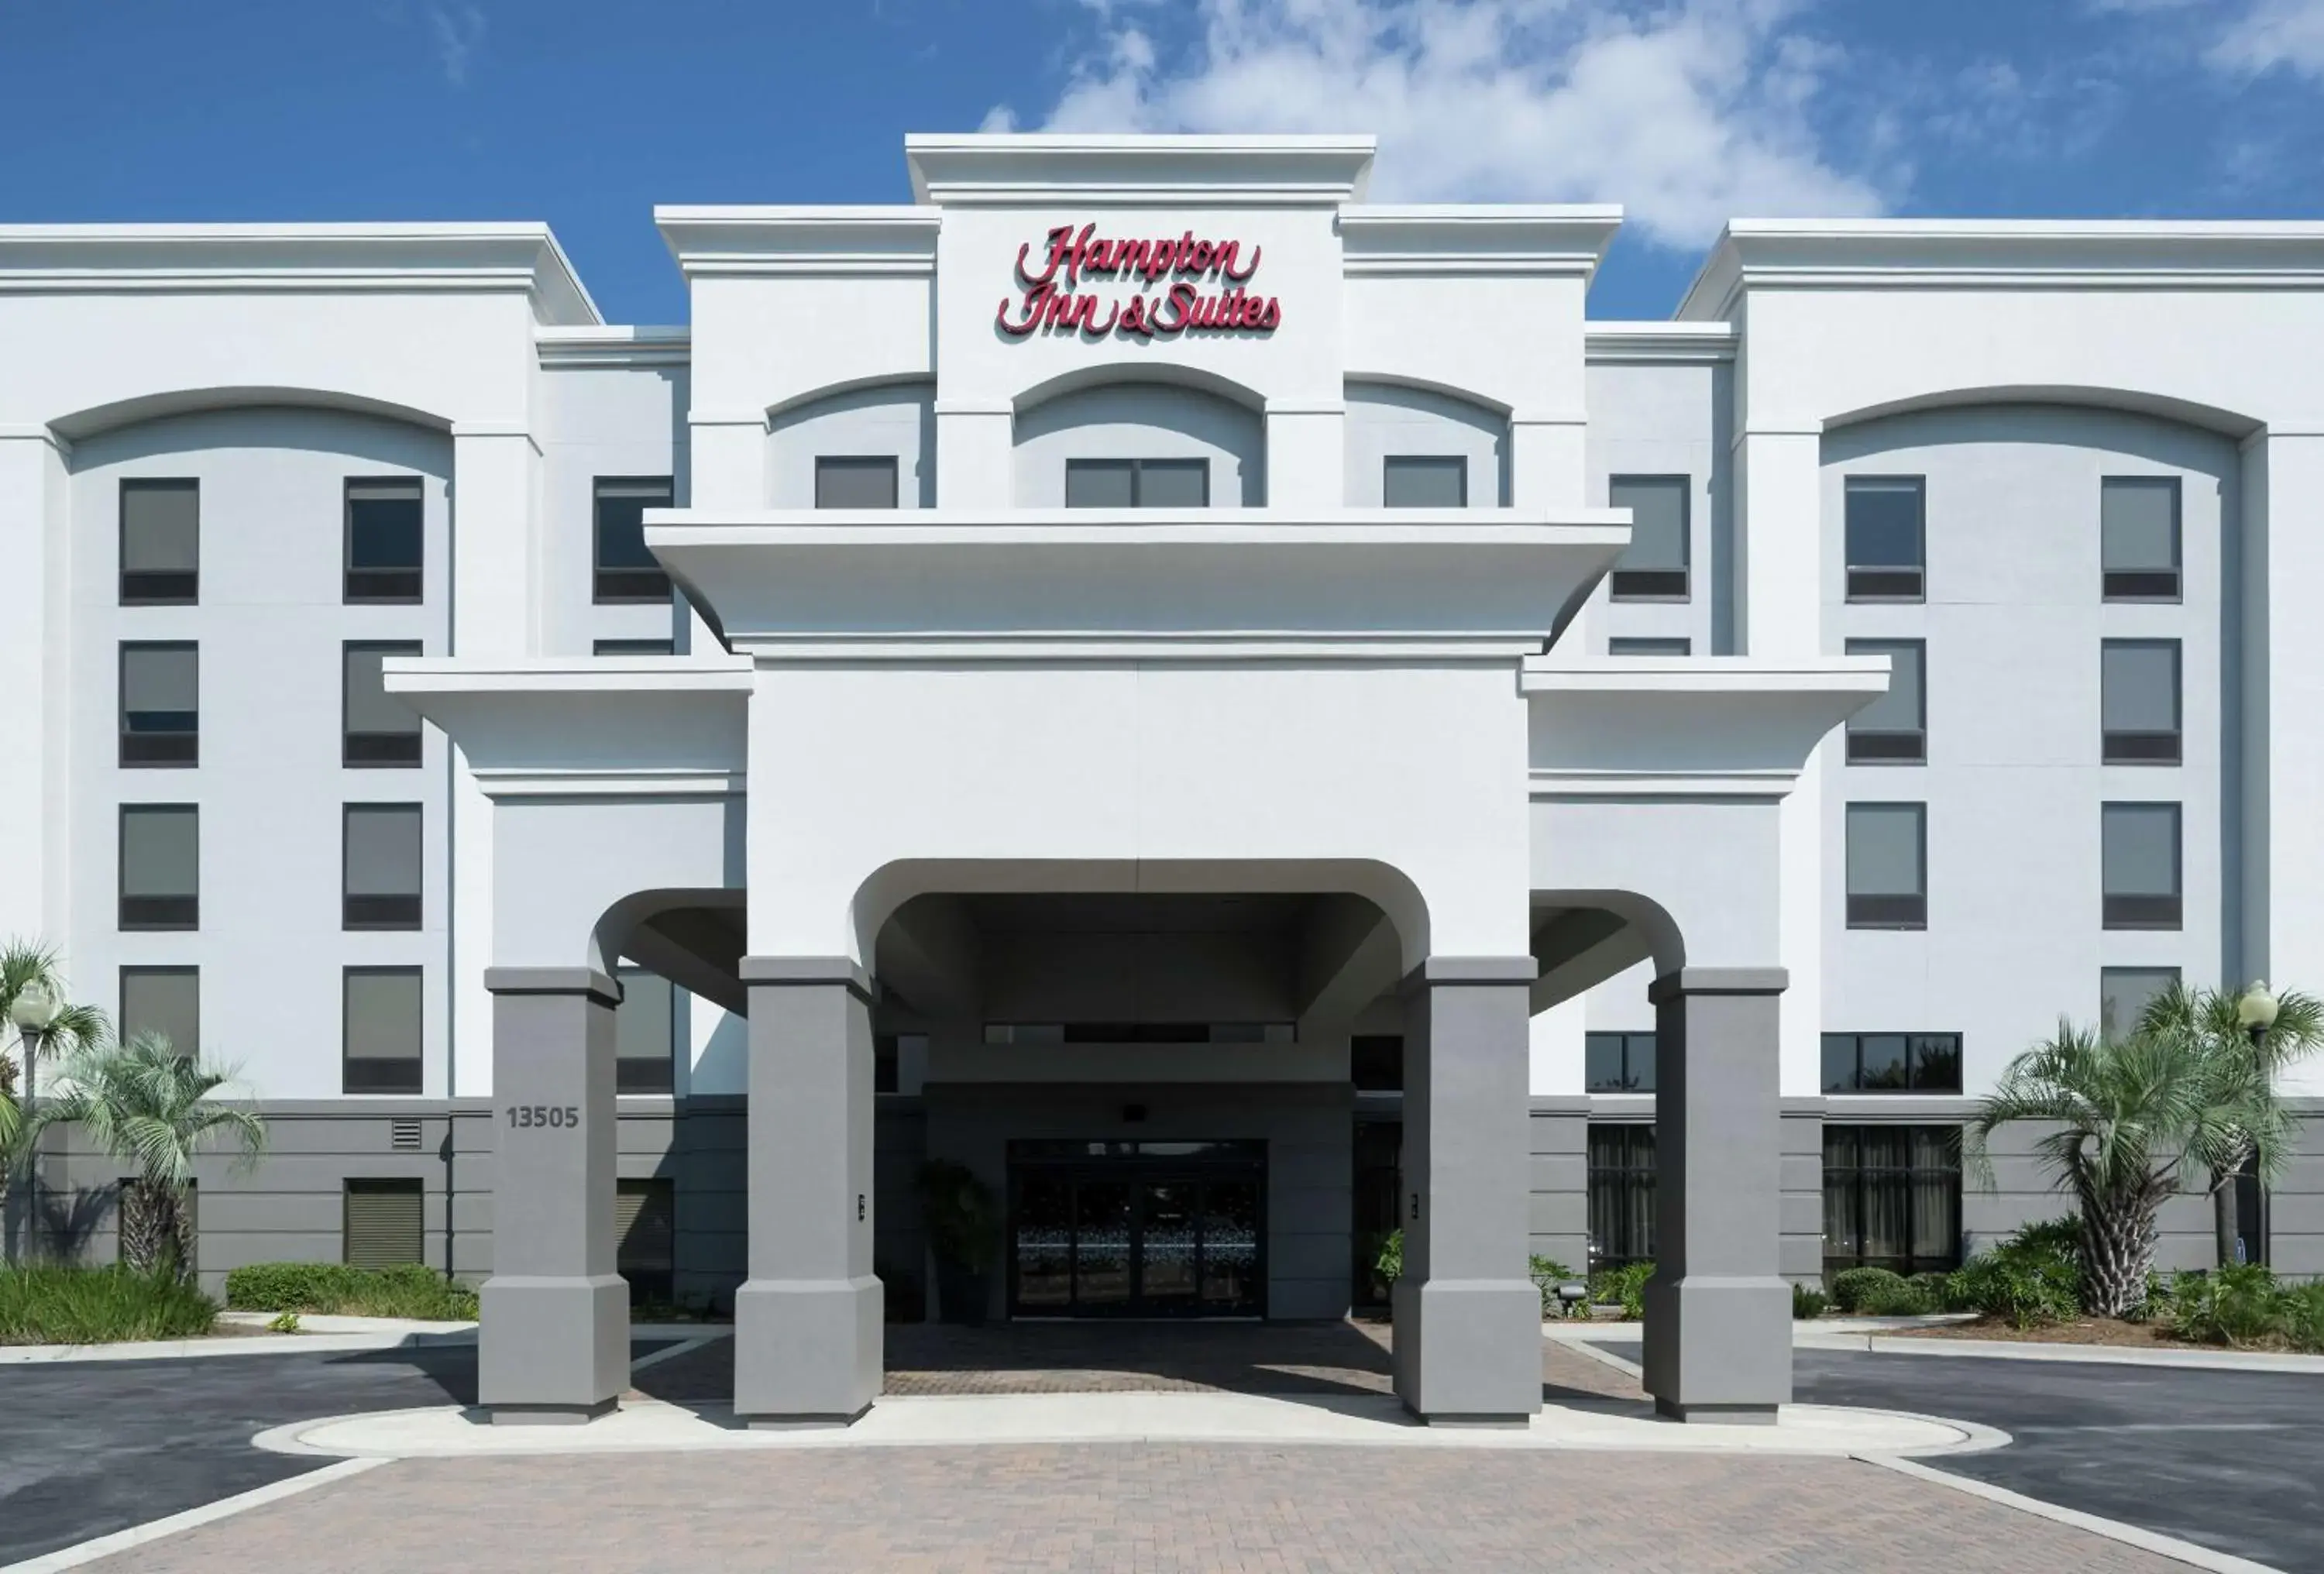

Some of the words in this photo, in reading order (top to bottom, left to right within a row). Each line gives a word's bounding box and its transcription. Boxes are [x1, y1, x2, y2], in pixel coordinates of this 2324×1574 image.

[1018, 222, 1260, 285] Hampton
[999, 282, 1119, 335] Inn
[1119, 294, 1153, 337] &
[1150, 283, 1281, 331] Suites
[506, 1106, 579, 1128] 13505
